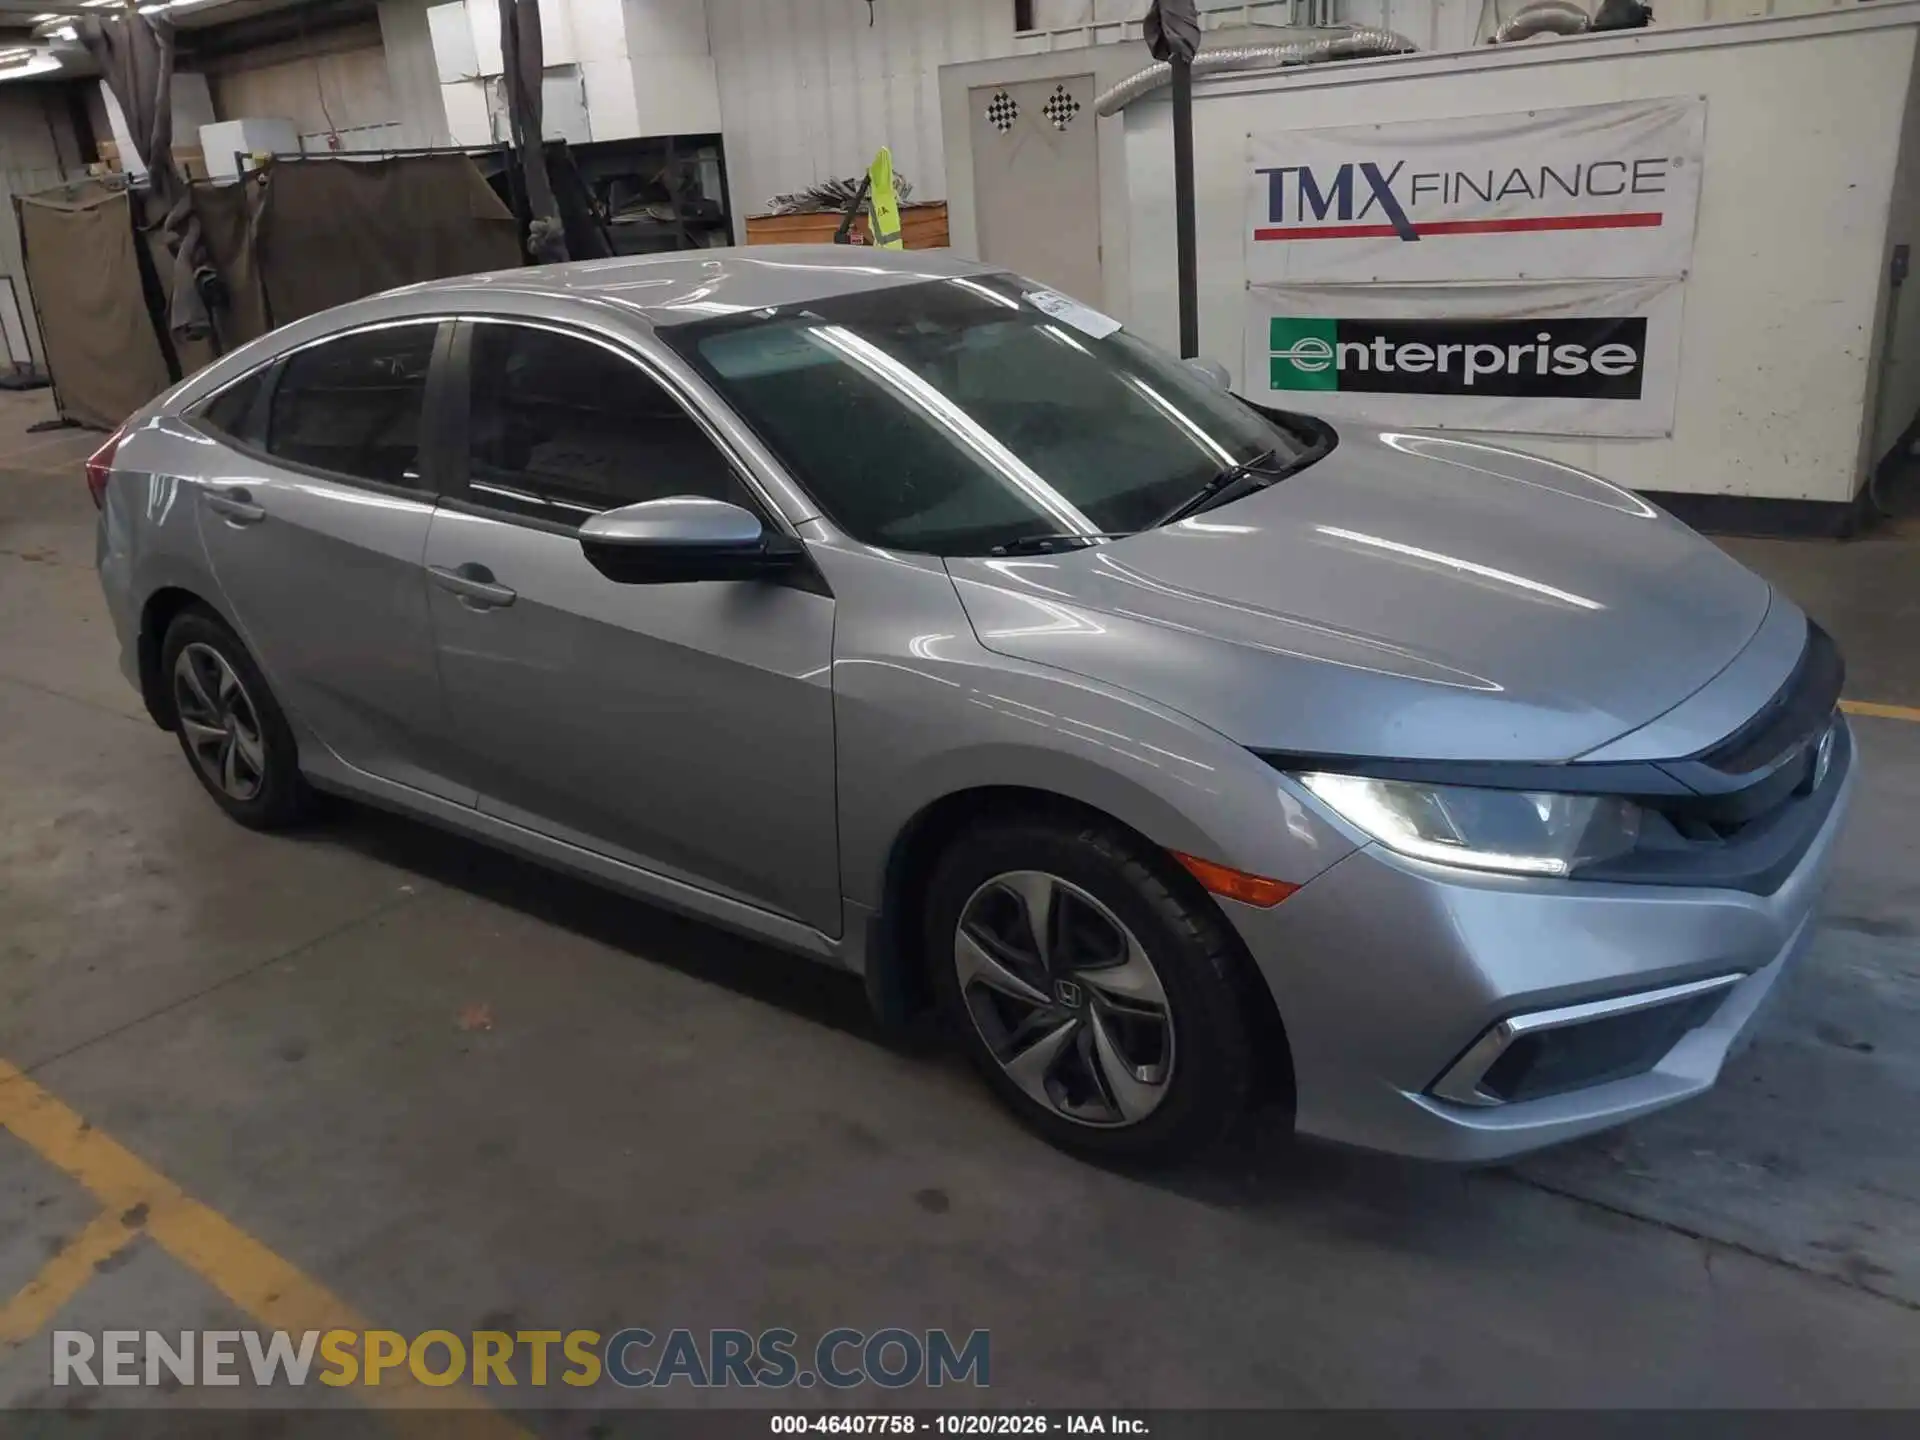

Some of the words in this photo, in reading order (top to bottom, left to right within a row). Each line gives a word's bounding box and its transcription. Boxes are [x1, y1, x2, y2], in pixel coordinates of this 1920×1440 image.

[1254, 160, 1421, 242] TMX
[1411, 157, 1669, 206] FINANCE
[1285, 332, 1638, 386] enterprise
